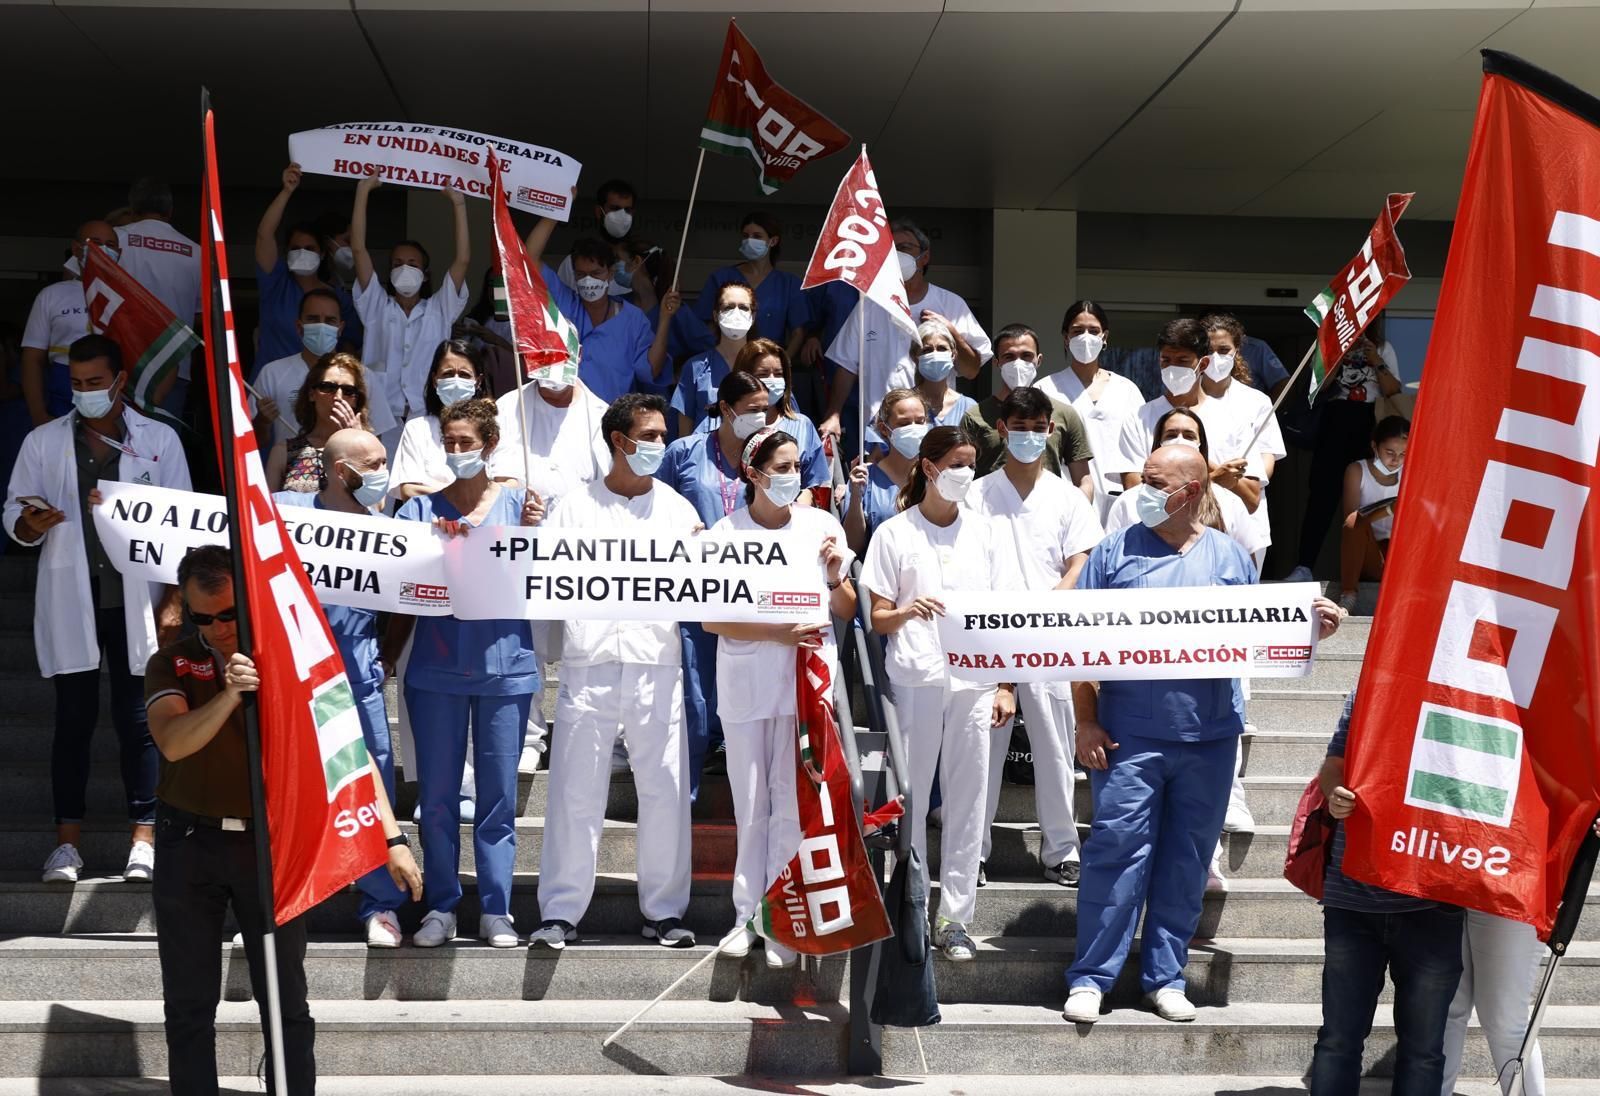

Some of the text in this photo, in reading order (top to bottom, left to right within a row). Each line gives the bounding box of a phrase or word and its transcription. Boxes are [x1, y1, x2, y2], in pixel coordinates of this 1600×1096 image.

[409, 124, 434, 134] DE
[343, 133, 372, 145] EN
[376, 135, 480, 165] UNIDADES
[530, 191, 557, 203] CCOO
[146, 239, 181, 251] CCOO
[111, 498, 153, 524] NO
[161, 505, 179, 528] A
[189, 508, 229, 534] LO
[129, 539, 164, 566] EN
[489, 537, 788, 566] +PLANTILLA PARA
[525, 575, 754, 604] FISIOTERAPIA
[774, 594, 810, 604] CCOO
[963, 606, 1308, 630] FISIOTERAPIA DOMICILIARIA
[947, 651, 1007, 669] PARA
[1012, 651, 1077, 669] TODA
[1081, 649, 1112, 667] LA
[1118, 644, 1248, 665] POBLACIÓN
[1270, 648, 1304, 658] CCOO
[1006, 751, 1034, 763] SPO
[779, 863, 807, 938] evilla
